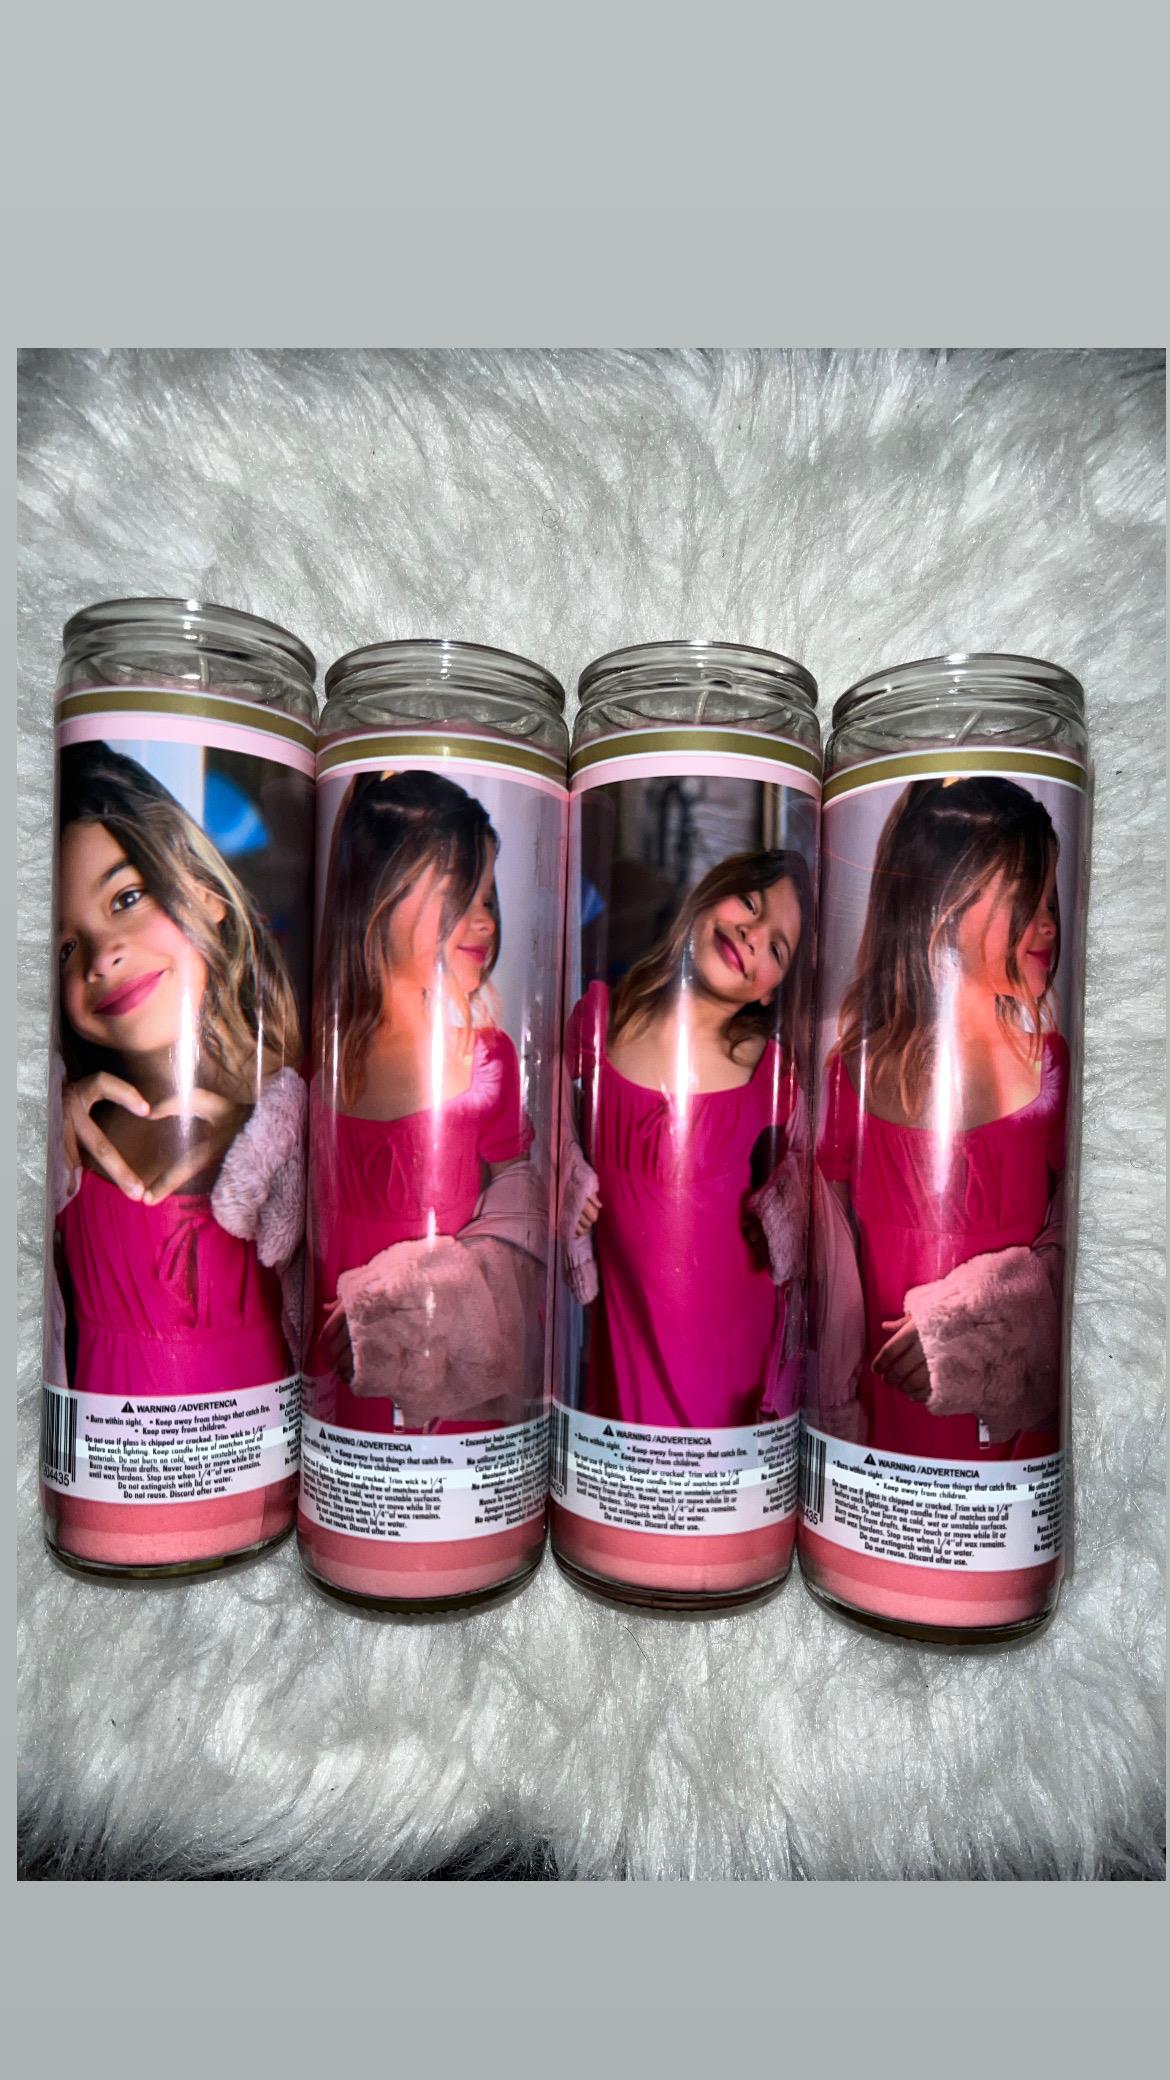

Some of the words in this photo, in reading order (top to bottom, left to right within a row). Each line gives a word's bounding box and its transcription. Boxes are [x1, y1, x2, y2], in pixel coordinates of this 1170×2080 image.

[91, 1415, 103, 1424] Burn
[105, 1417, 123, 1425] within
[174, 1418, 192, 1426] away
[212, 1413, 231, 1422] things
[246, 1407, 259, 1416] catch
[123, 1439, 139, 1447] glass
[148, 1438, 174, 1446] chipped
[186, 1436, 212, 1444] cracked.
[90, 1461, 102, 1470] Burn
[104, 1464, 120, 1474] away
[139, 1464, 160, 1473] drafts.
[184, 1461, 202, 1470] touch
[850, 1465, 866, 1475] within
[879, 1460, 916, 1473] WARNING
[141, 1481, 176, 1491] extinguish
[214, 1476, 232, 1484] water.
[884, 1483, 899, 1492] Keep
[901, 1488, 918, 1496] away
[895, 1476, 912, 1485] Keep
[914, 1480, 931, 1488] away
[934, 1481, 950, 1489] from
[952, 1483, 972, 1491] things
[170, 1489, 194, 1498] Discard
[865, 1491, 880, 1500] glass
[888, 1494, 914, 1507] chipped
[925, 1502, 952, 1510] cracked.
[848, 1511, 862, 1520] away
[864, 1516, 878, 1525] from
[880, 1520, 898, 1530] drafts.
[902, 1525, 921, 1534] Never
[924, 1528, 941, 1536] touch
[881, 1537, 914, 1550] extinguish
[917, 1544, 931, 1553] with
[887, 1549, 906, 1558] reuse.
[909, 1552, 933, 1562] Discard
